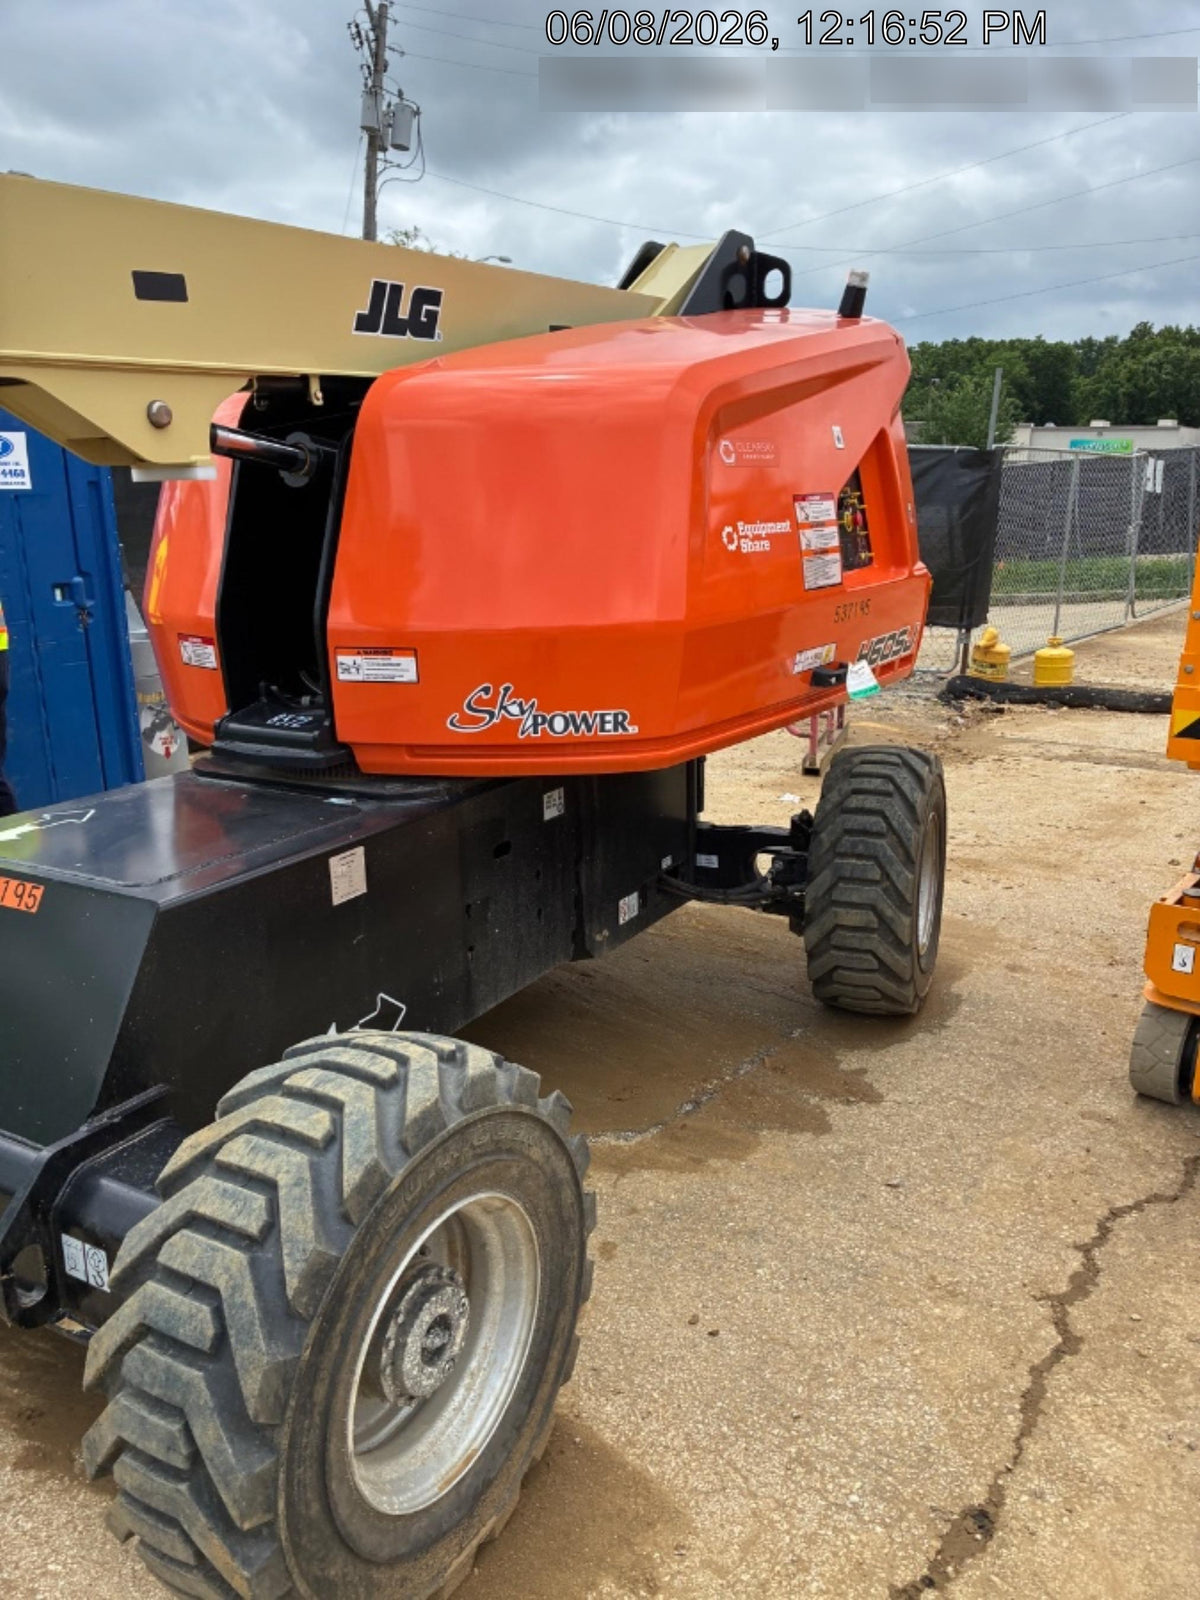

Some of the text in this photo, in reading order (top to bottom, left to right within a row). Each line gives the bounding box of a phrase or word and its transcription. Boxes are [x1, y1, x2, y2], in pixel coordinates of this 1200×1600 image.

[352, 278, 444, 341] JLG
[737, 520, 790, 538] Equipment
[740, 538, 771, 553] Share
[833, 598, 871, 623] 537195
